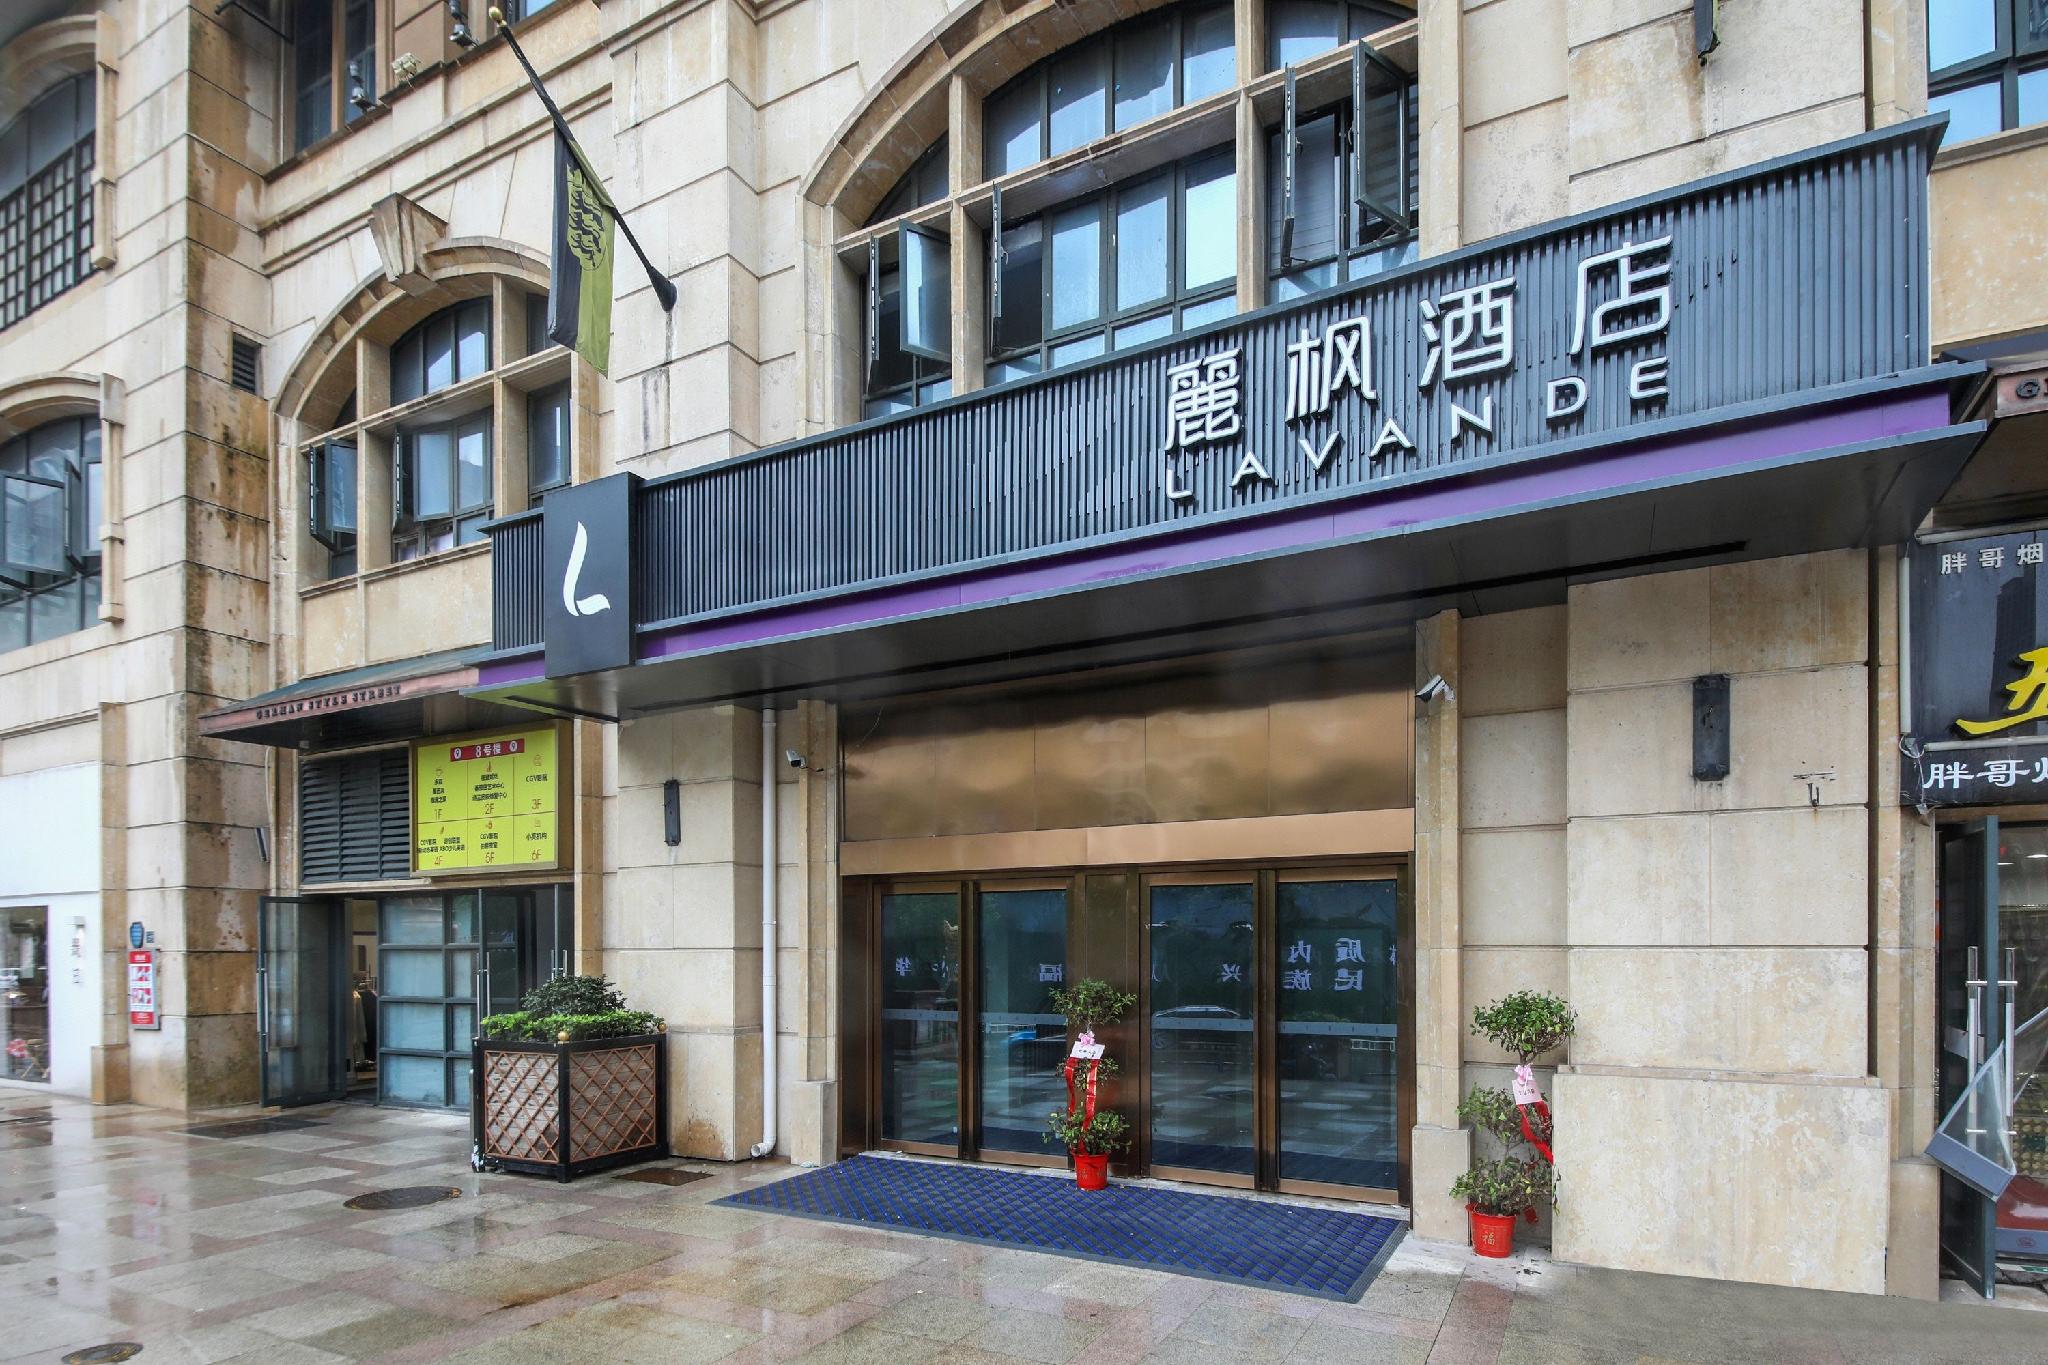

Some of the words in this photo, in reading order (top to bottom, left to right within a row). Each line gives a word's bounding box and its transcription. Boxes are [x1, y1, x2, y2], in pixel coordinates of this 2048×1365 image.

[2015, 378, 2048, 400] G
[1166, 355, 1668, 500] LAVANDE
[1941, 543, 2045, 575] 胖哥烟
[309, 694, 348, 711] STYLE
[352, 684, 401, 702] STREET
[485, 803, 494, 815] 2F
[532, 799, 541, 810] 3F
[434, 809, 443, 820] 1F
[485, 852, 494, 864] 5F
[532, 850, 541, 861] 6F
